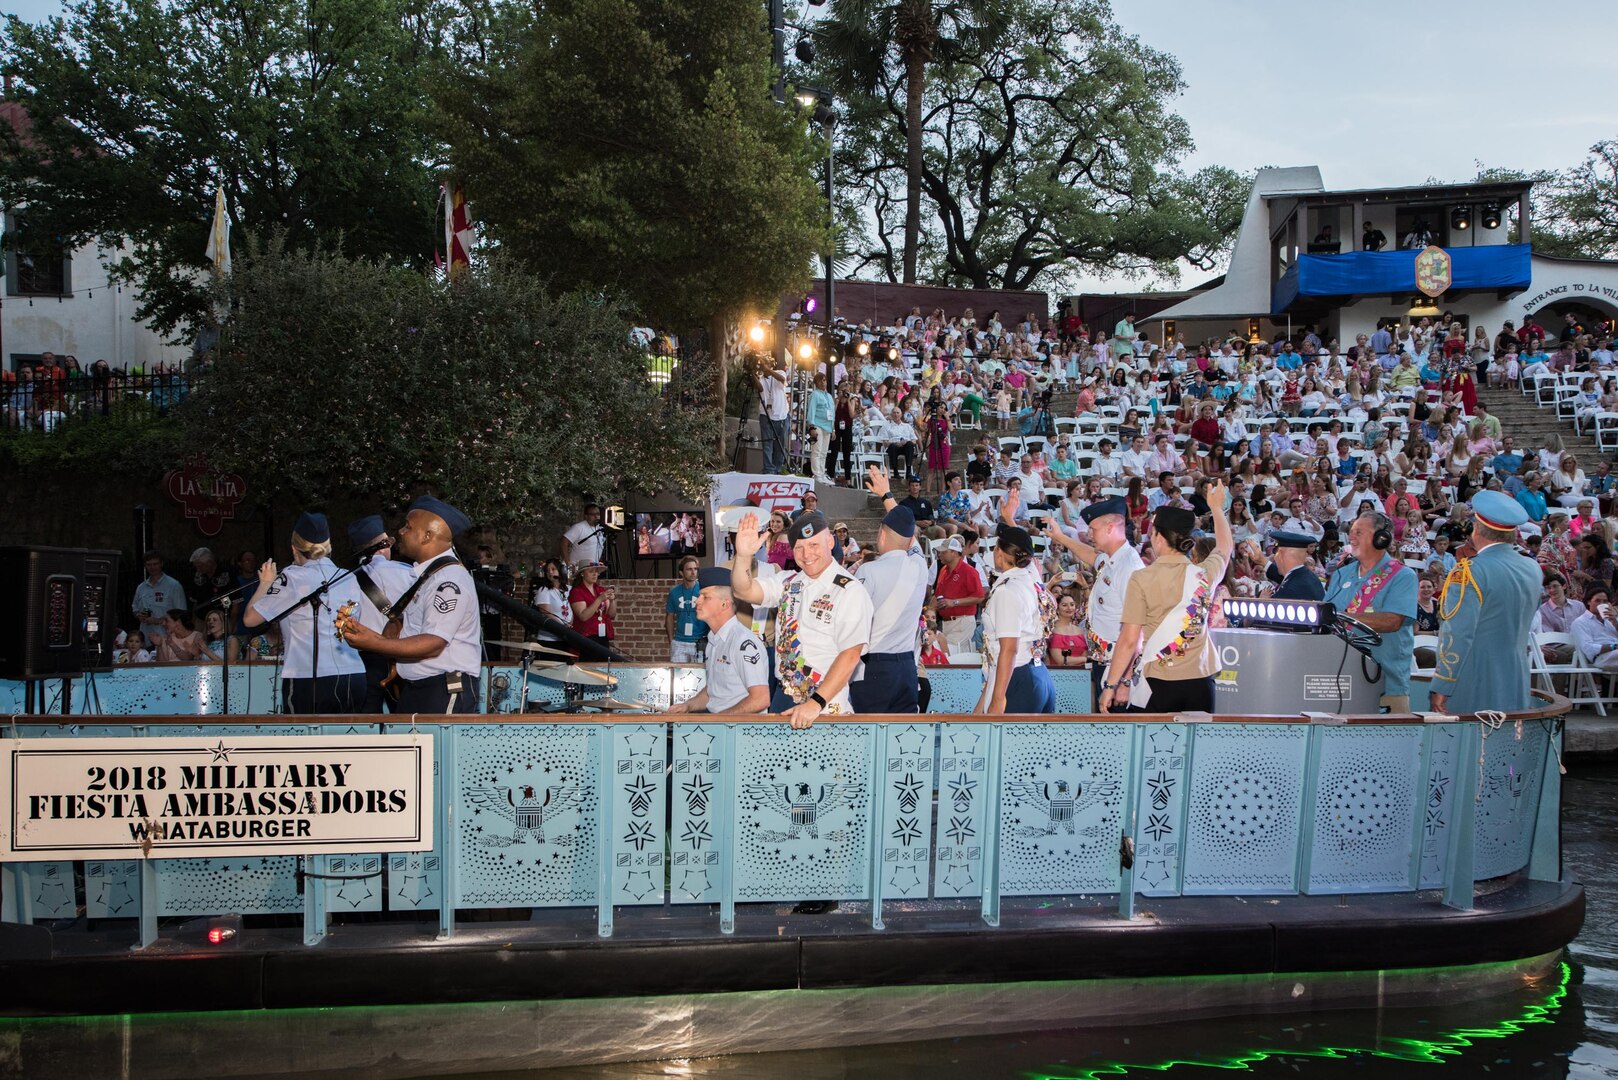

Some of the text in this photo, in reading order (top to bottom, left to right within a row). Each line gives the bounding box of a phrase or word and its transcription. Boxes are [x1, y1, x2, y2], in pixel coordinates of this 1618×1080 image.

[1523, 286, 1567, 311] ENTRANCE
[1589, 284, 1600, 293] LA
[180, 477, 238, 497] LA VLLITA
[759, 483, 809, 497] KSAT
[87, 763, 352, 792] 2018 MILITARY
[29, 788, 407, 820] FIESTA AMBASSADORS
[128, 819, 312, 841] WHATABURGER
